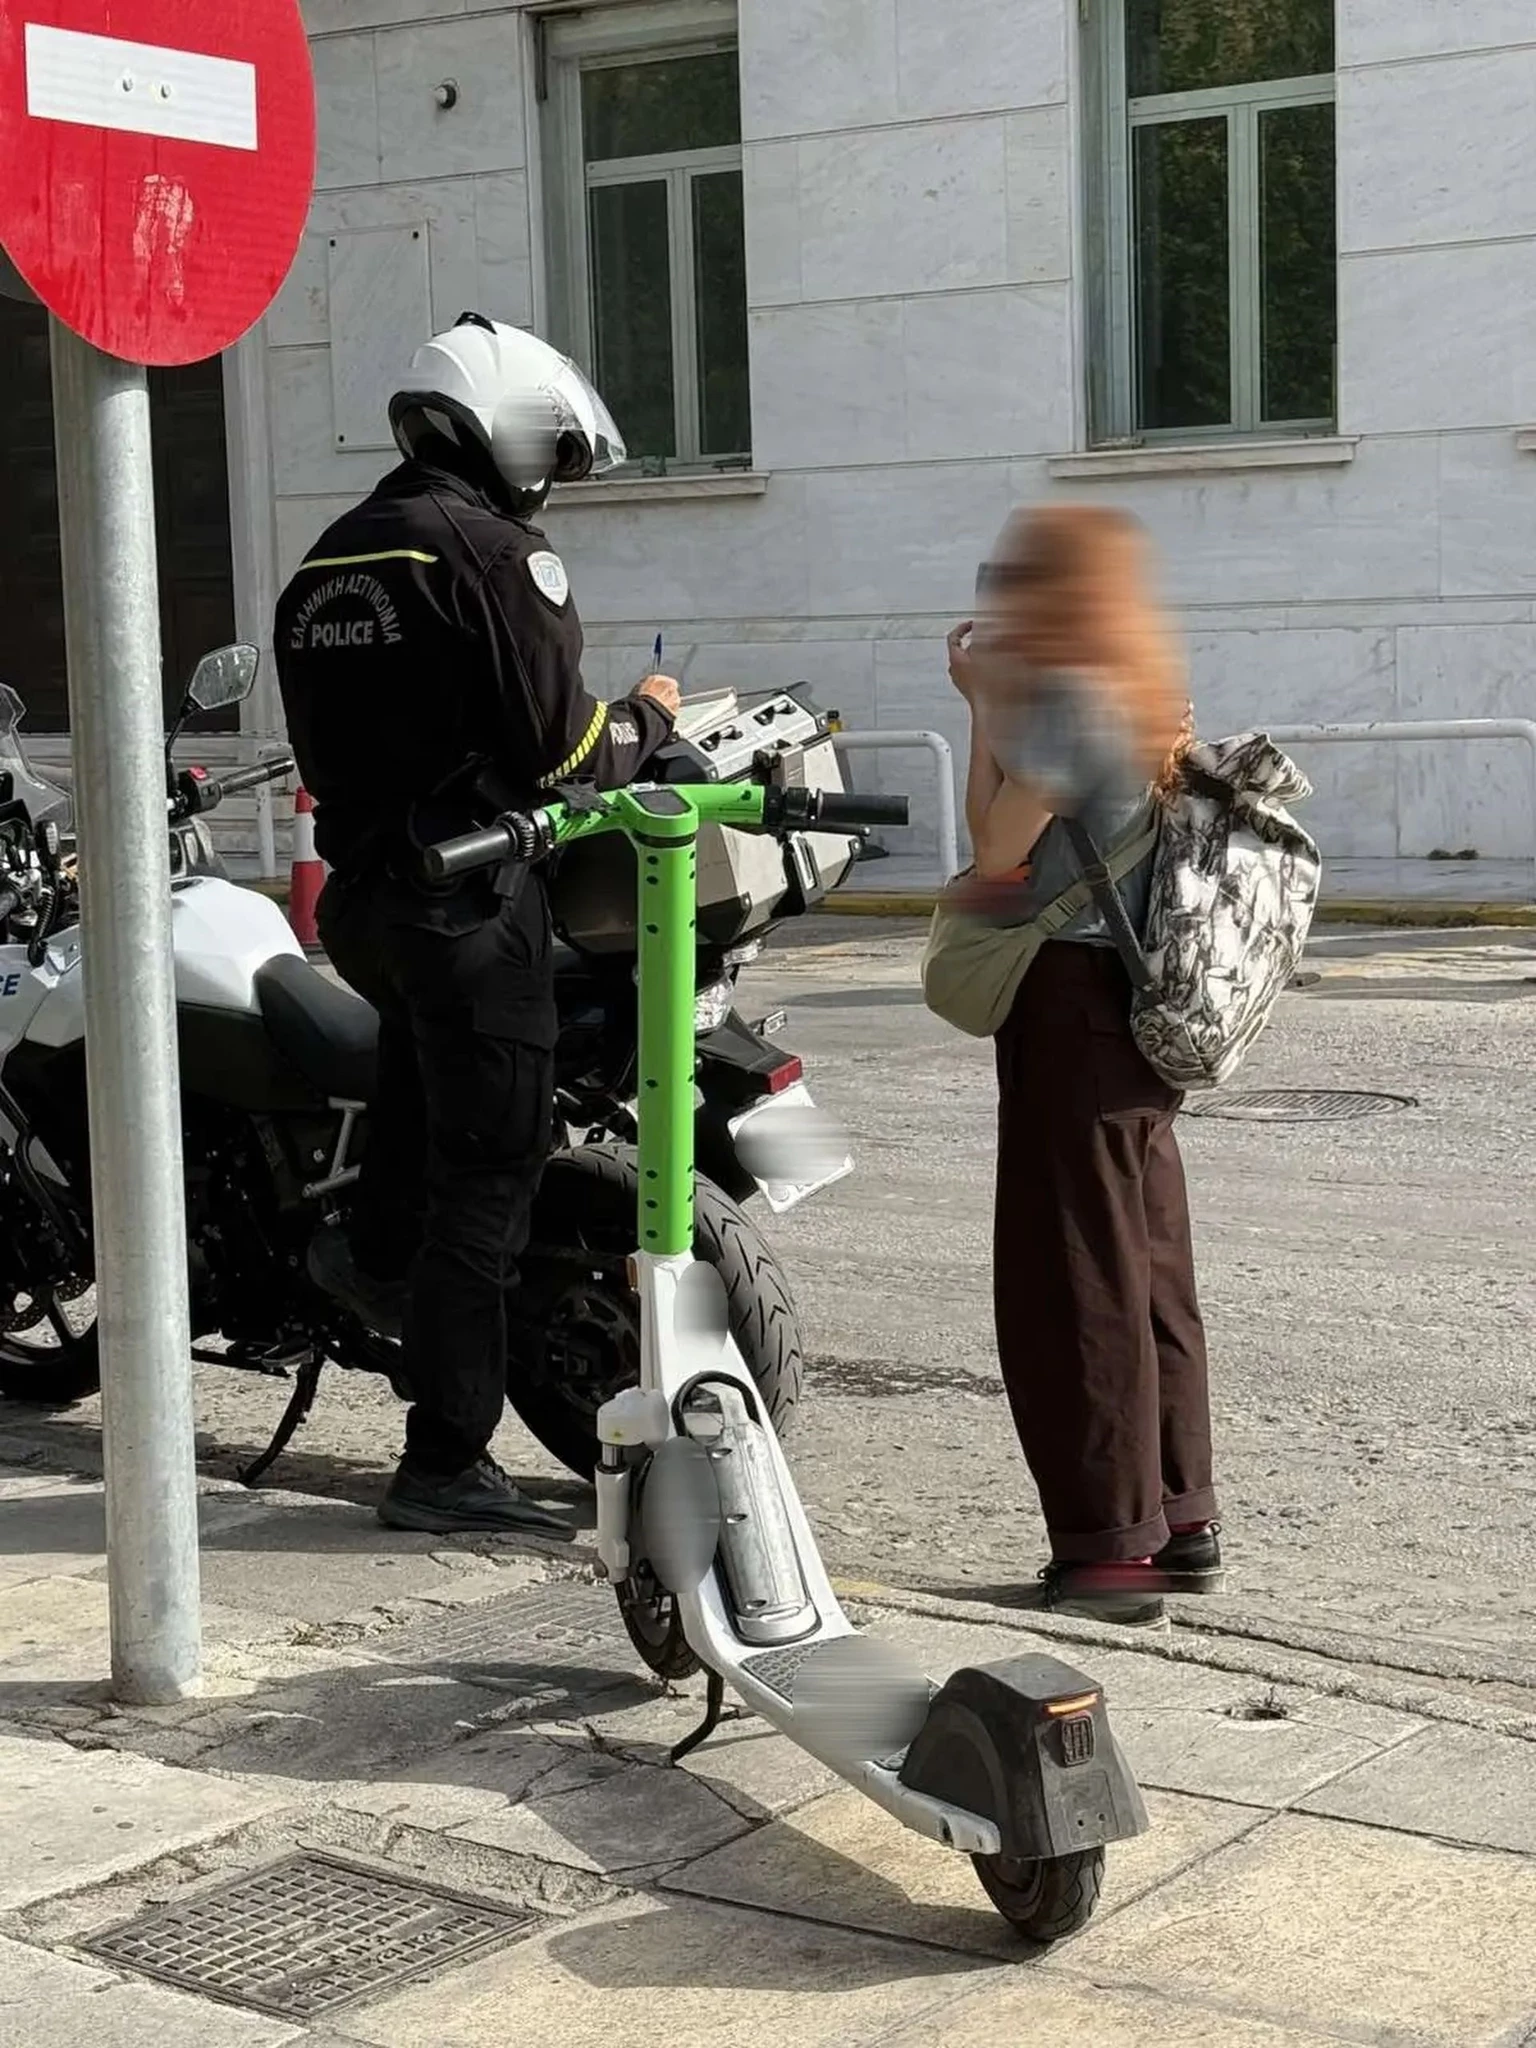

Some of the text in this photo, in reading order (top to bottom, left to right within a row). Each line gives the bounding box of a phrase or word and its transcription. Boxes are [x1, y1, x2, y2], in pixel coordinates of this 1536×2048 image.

[291, 573, 402, 649] ΕΛΛΗΝΙΚΗ ΑΣΤΥΝΟΜΙΑ
[311, 621, 374, 648] POLICE
